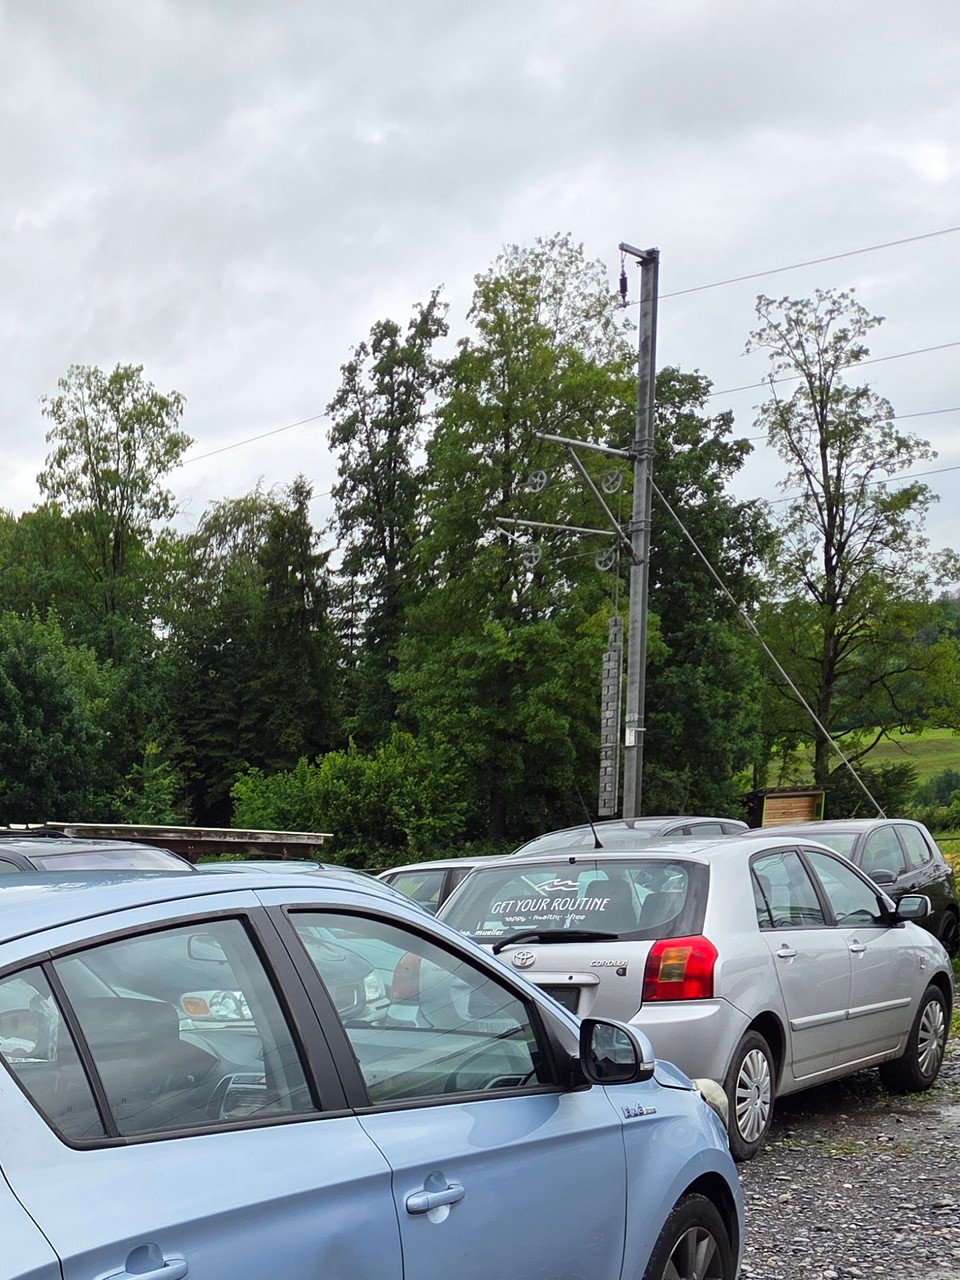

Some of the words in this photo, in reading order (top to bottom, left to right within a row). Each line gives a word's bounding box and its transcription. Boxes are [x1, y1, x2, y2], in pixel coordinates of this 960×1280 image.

[491, 901, 515, 914] GET
[515, 898, 551, 912] YOUR
[550, 897, 610, 912] ROUTINE
